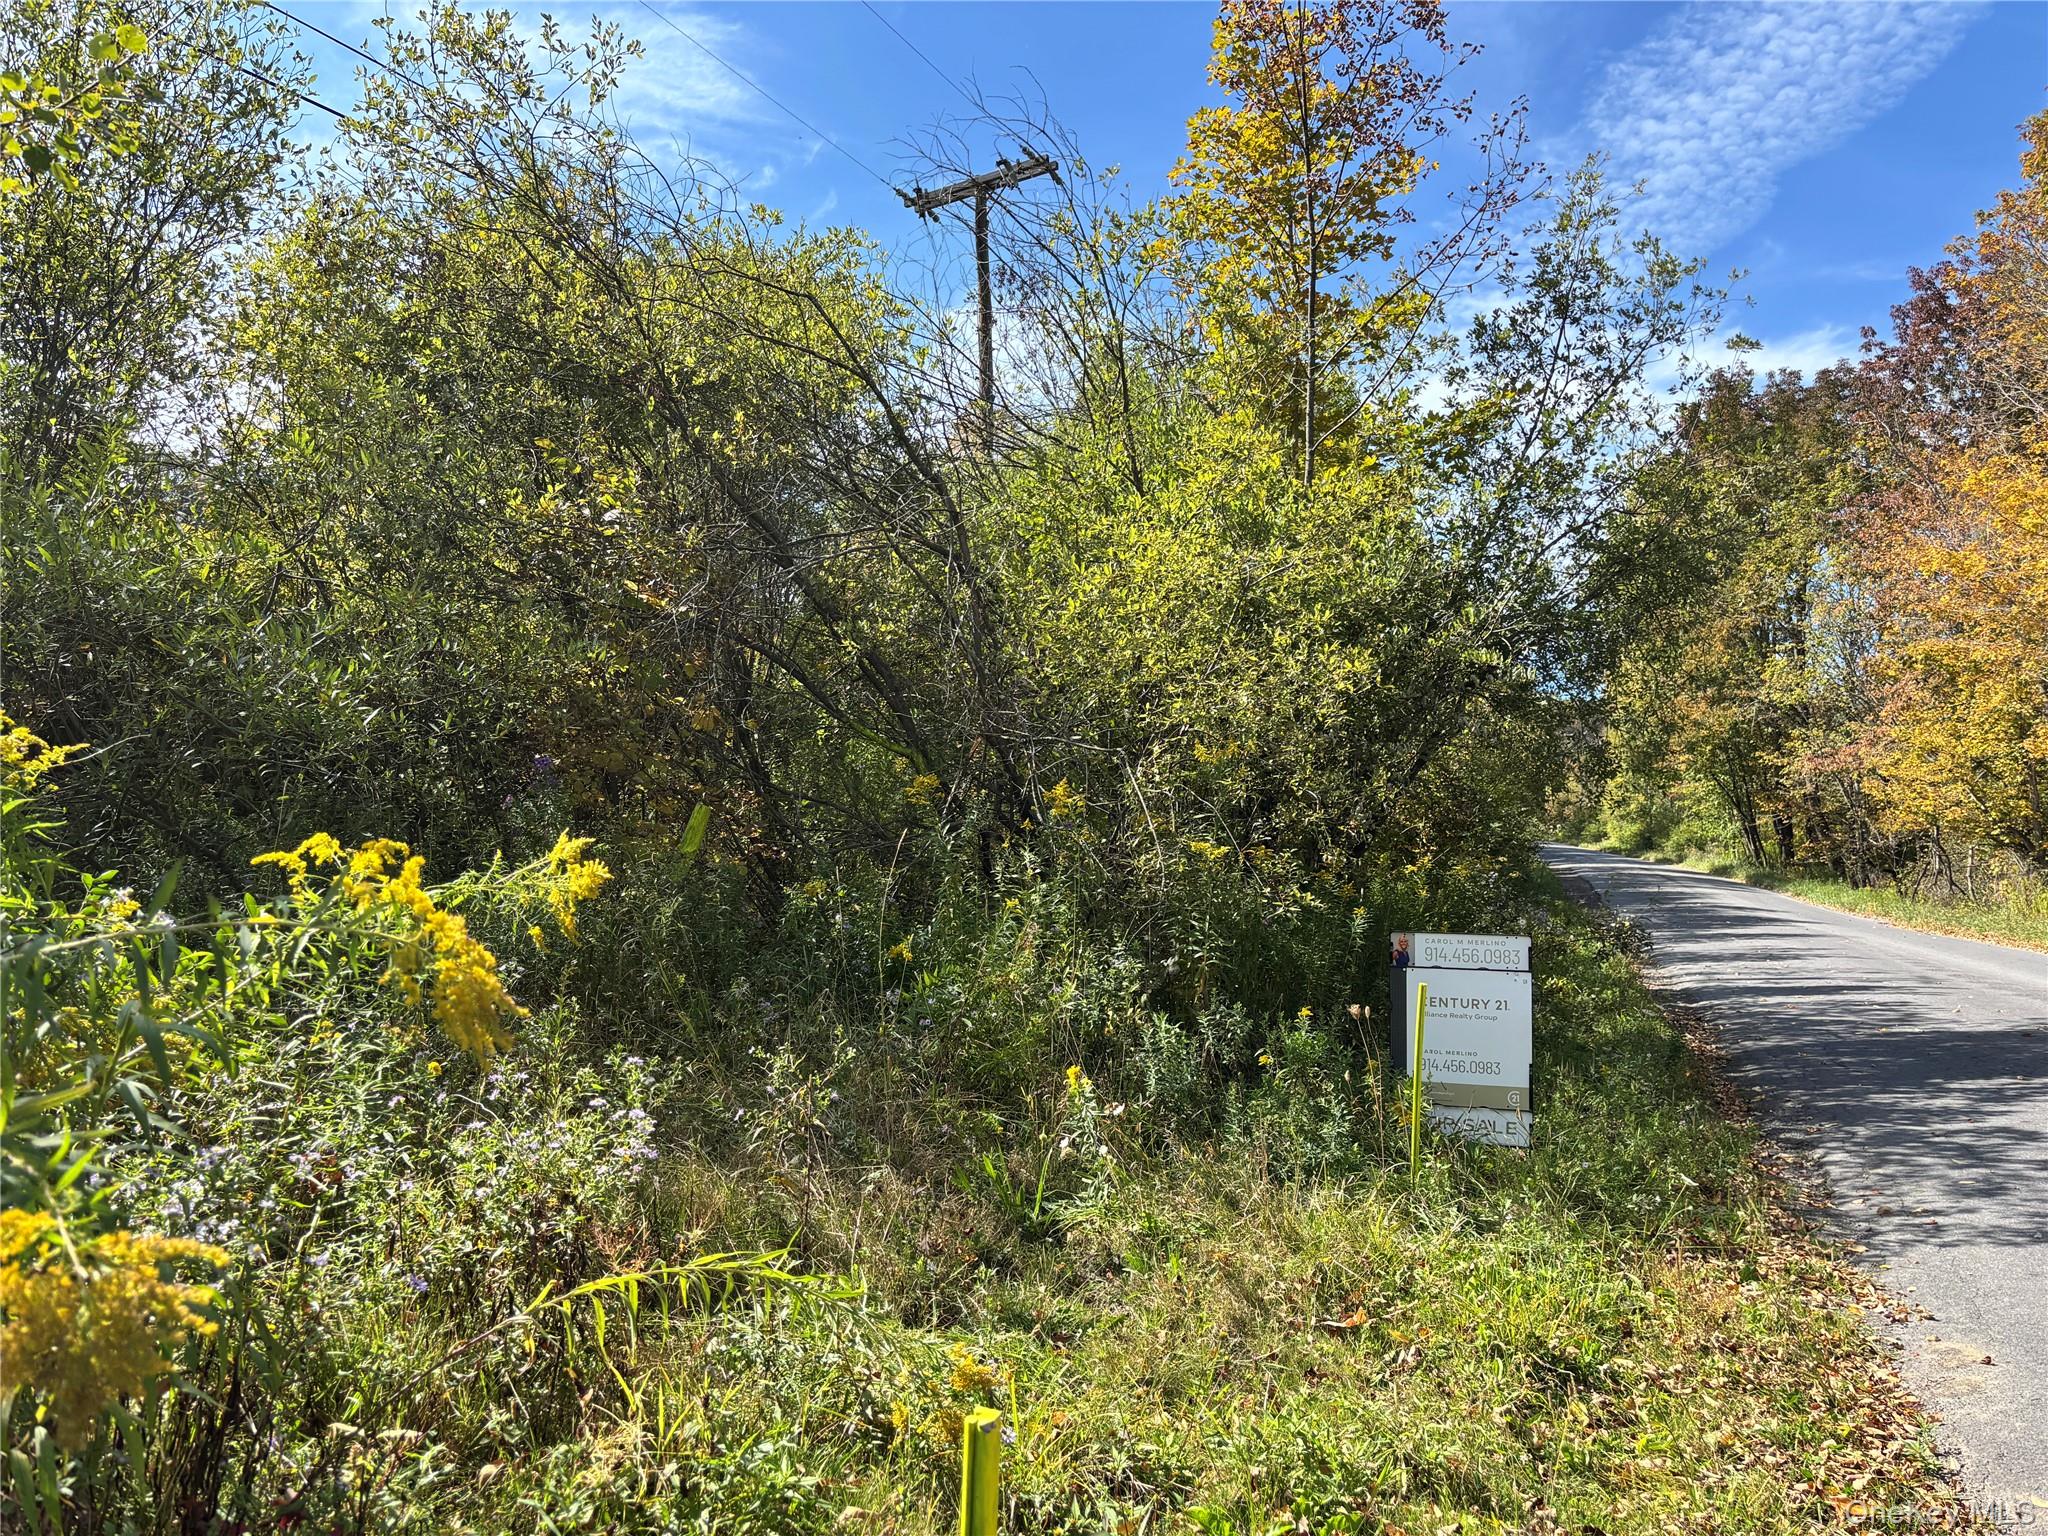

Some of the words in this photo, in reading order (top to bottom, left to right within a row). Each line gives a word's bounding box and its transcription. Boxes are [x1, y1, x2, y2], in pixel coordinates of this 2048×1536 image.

[1424, 938, 1454, 946] CAROL
[1424, 946, 1521, 965] 914.456.0983
[1449, 1013, 1473, 1021] Realty
[1474, 1013, 1498, 1021] Group
[1421, 1058, 1501, 1076] 914.456.0983
